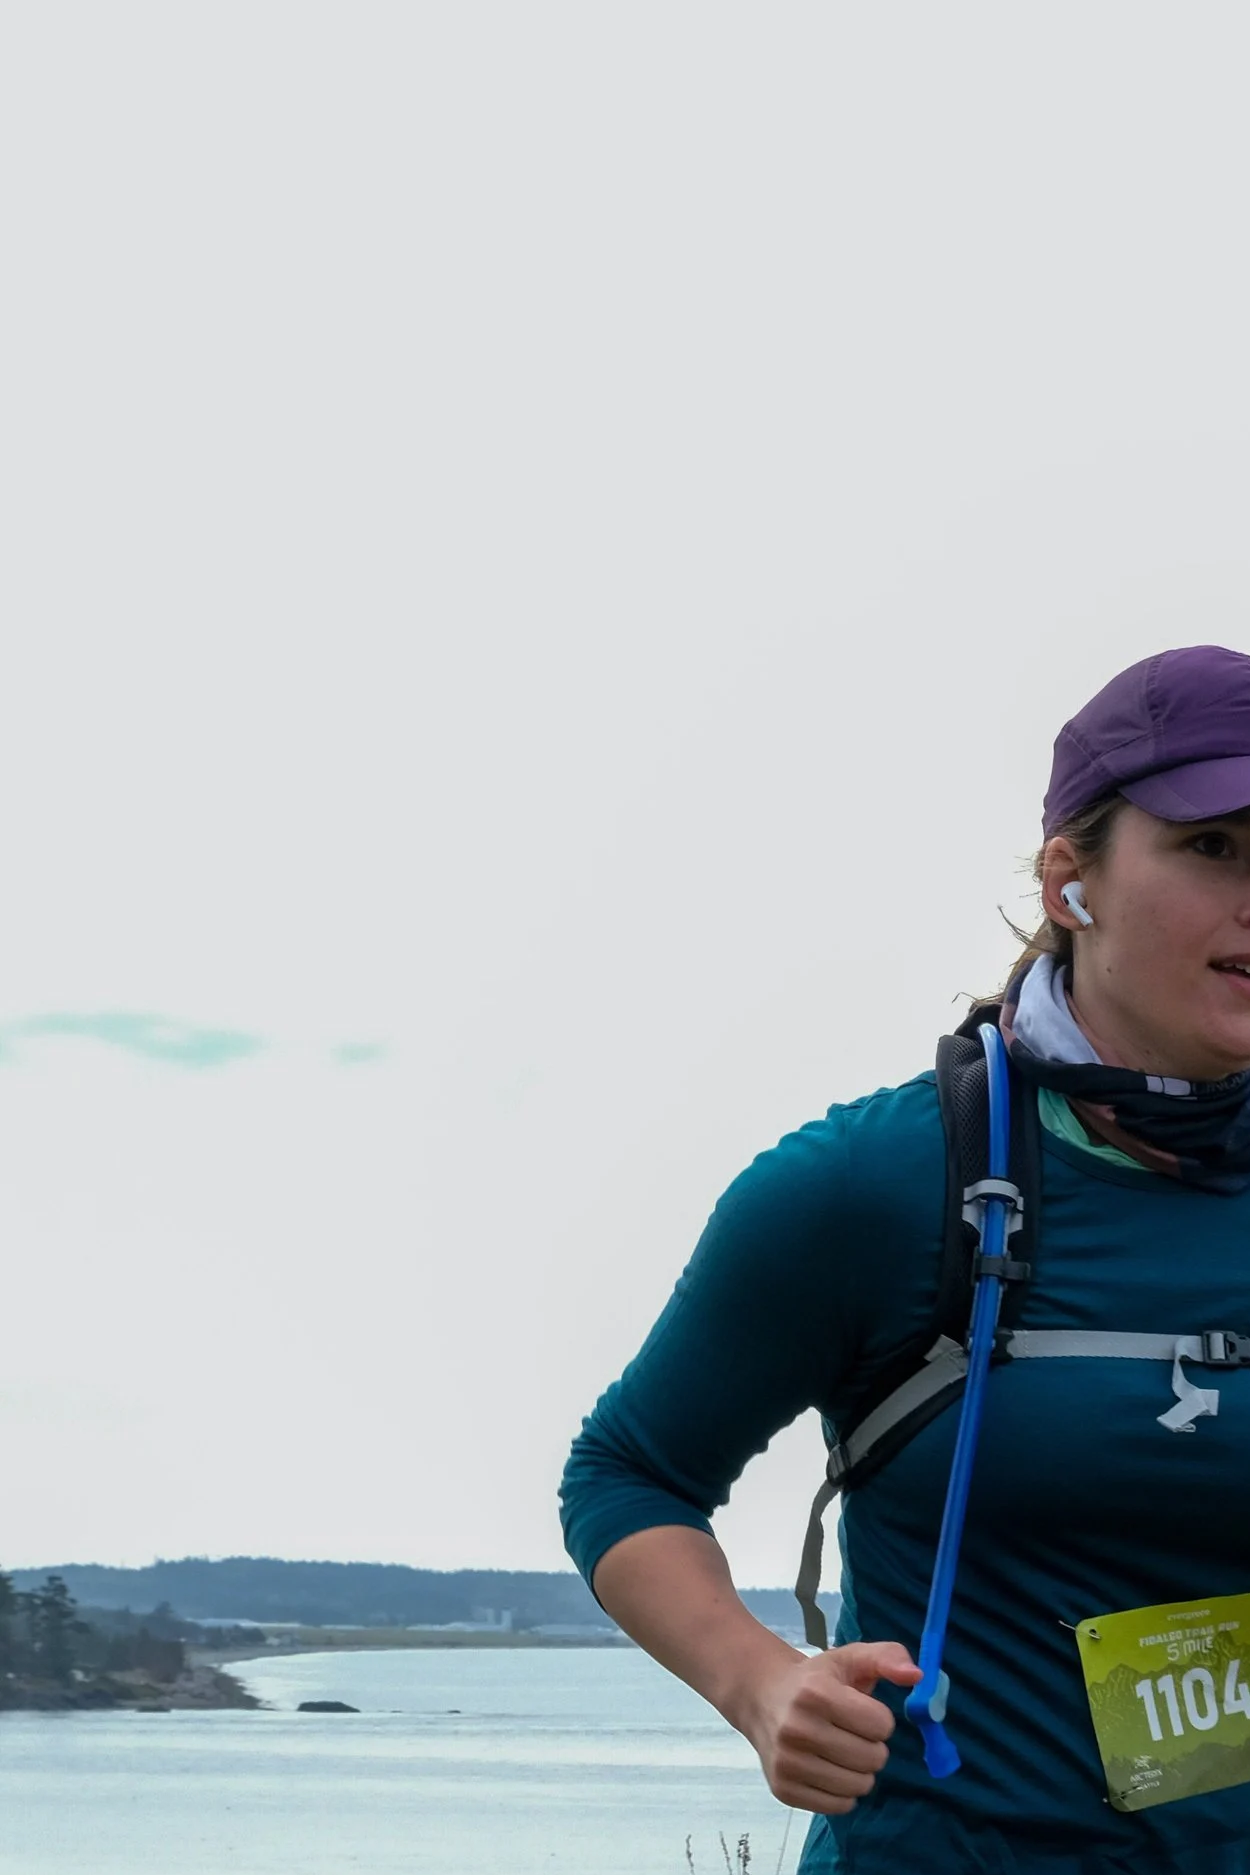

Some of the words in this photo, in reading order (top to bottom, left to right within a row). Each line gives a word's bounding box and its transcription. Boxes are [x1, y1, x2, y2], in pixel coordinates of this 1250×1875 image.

[1139, 1630, 1183, 1648] FIDALGO
[1184, 1624, 1215, 1638] TRAIL
[1167, 1643, 1180, 1661] 5
[1183, 1636, 1214, 1657] MILE
